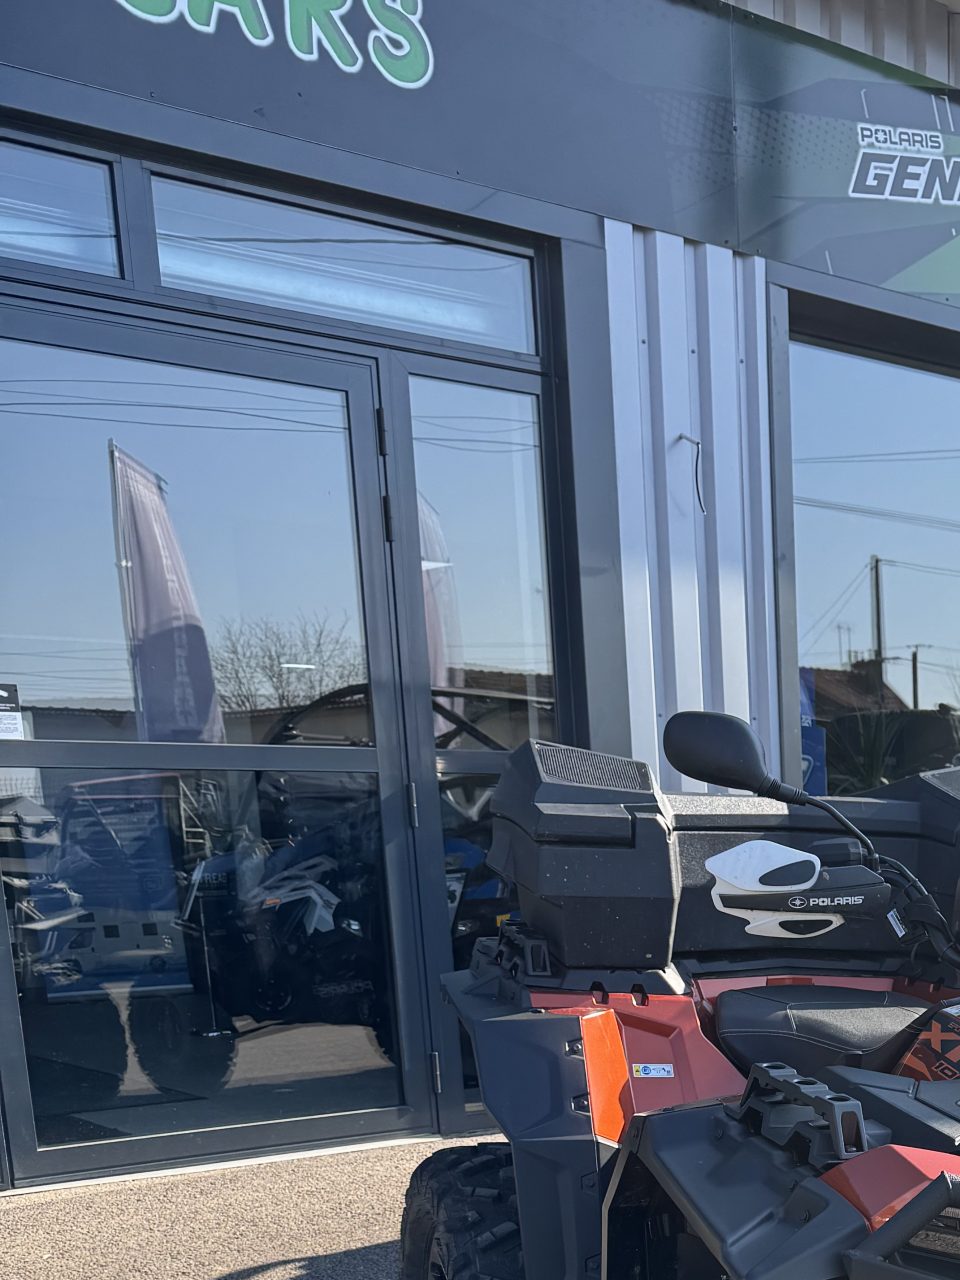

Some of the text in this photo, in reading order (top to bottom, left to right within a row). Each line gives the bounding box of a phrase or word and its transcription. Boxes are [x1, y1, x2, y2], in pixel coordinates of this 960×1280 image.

[113, 0, 434, 89] RS
[859, 125, 944, 150] POLARIS
[809, 895, 865, 907] POLARIS
